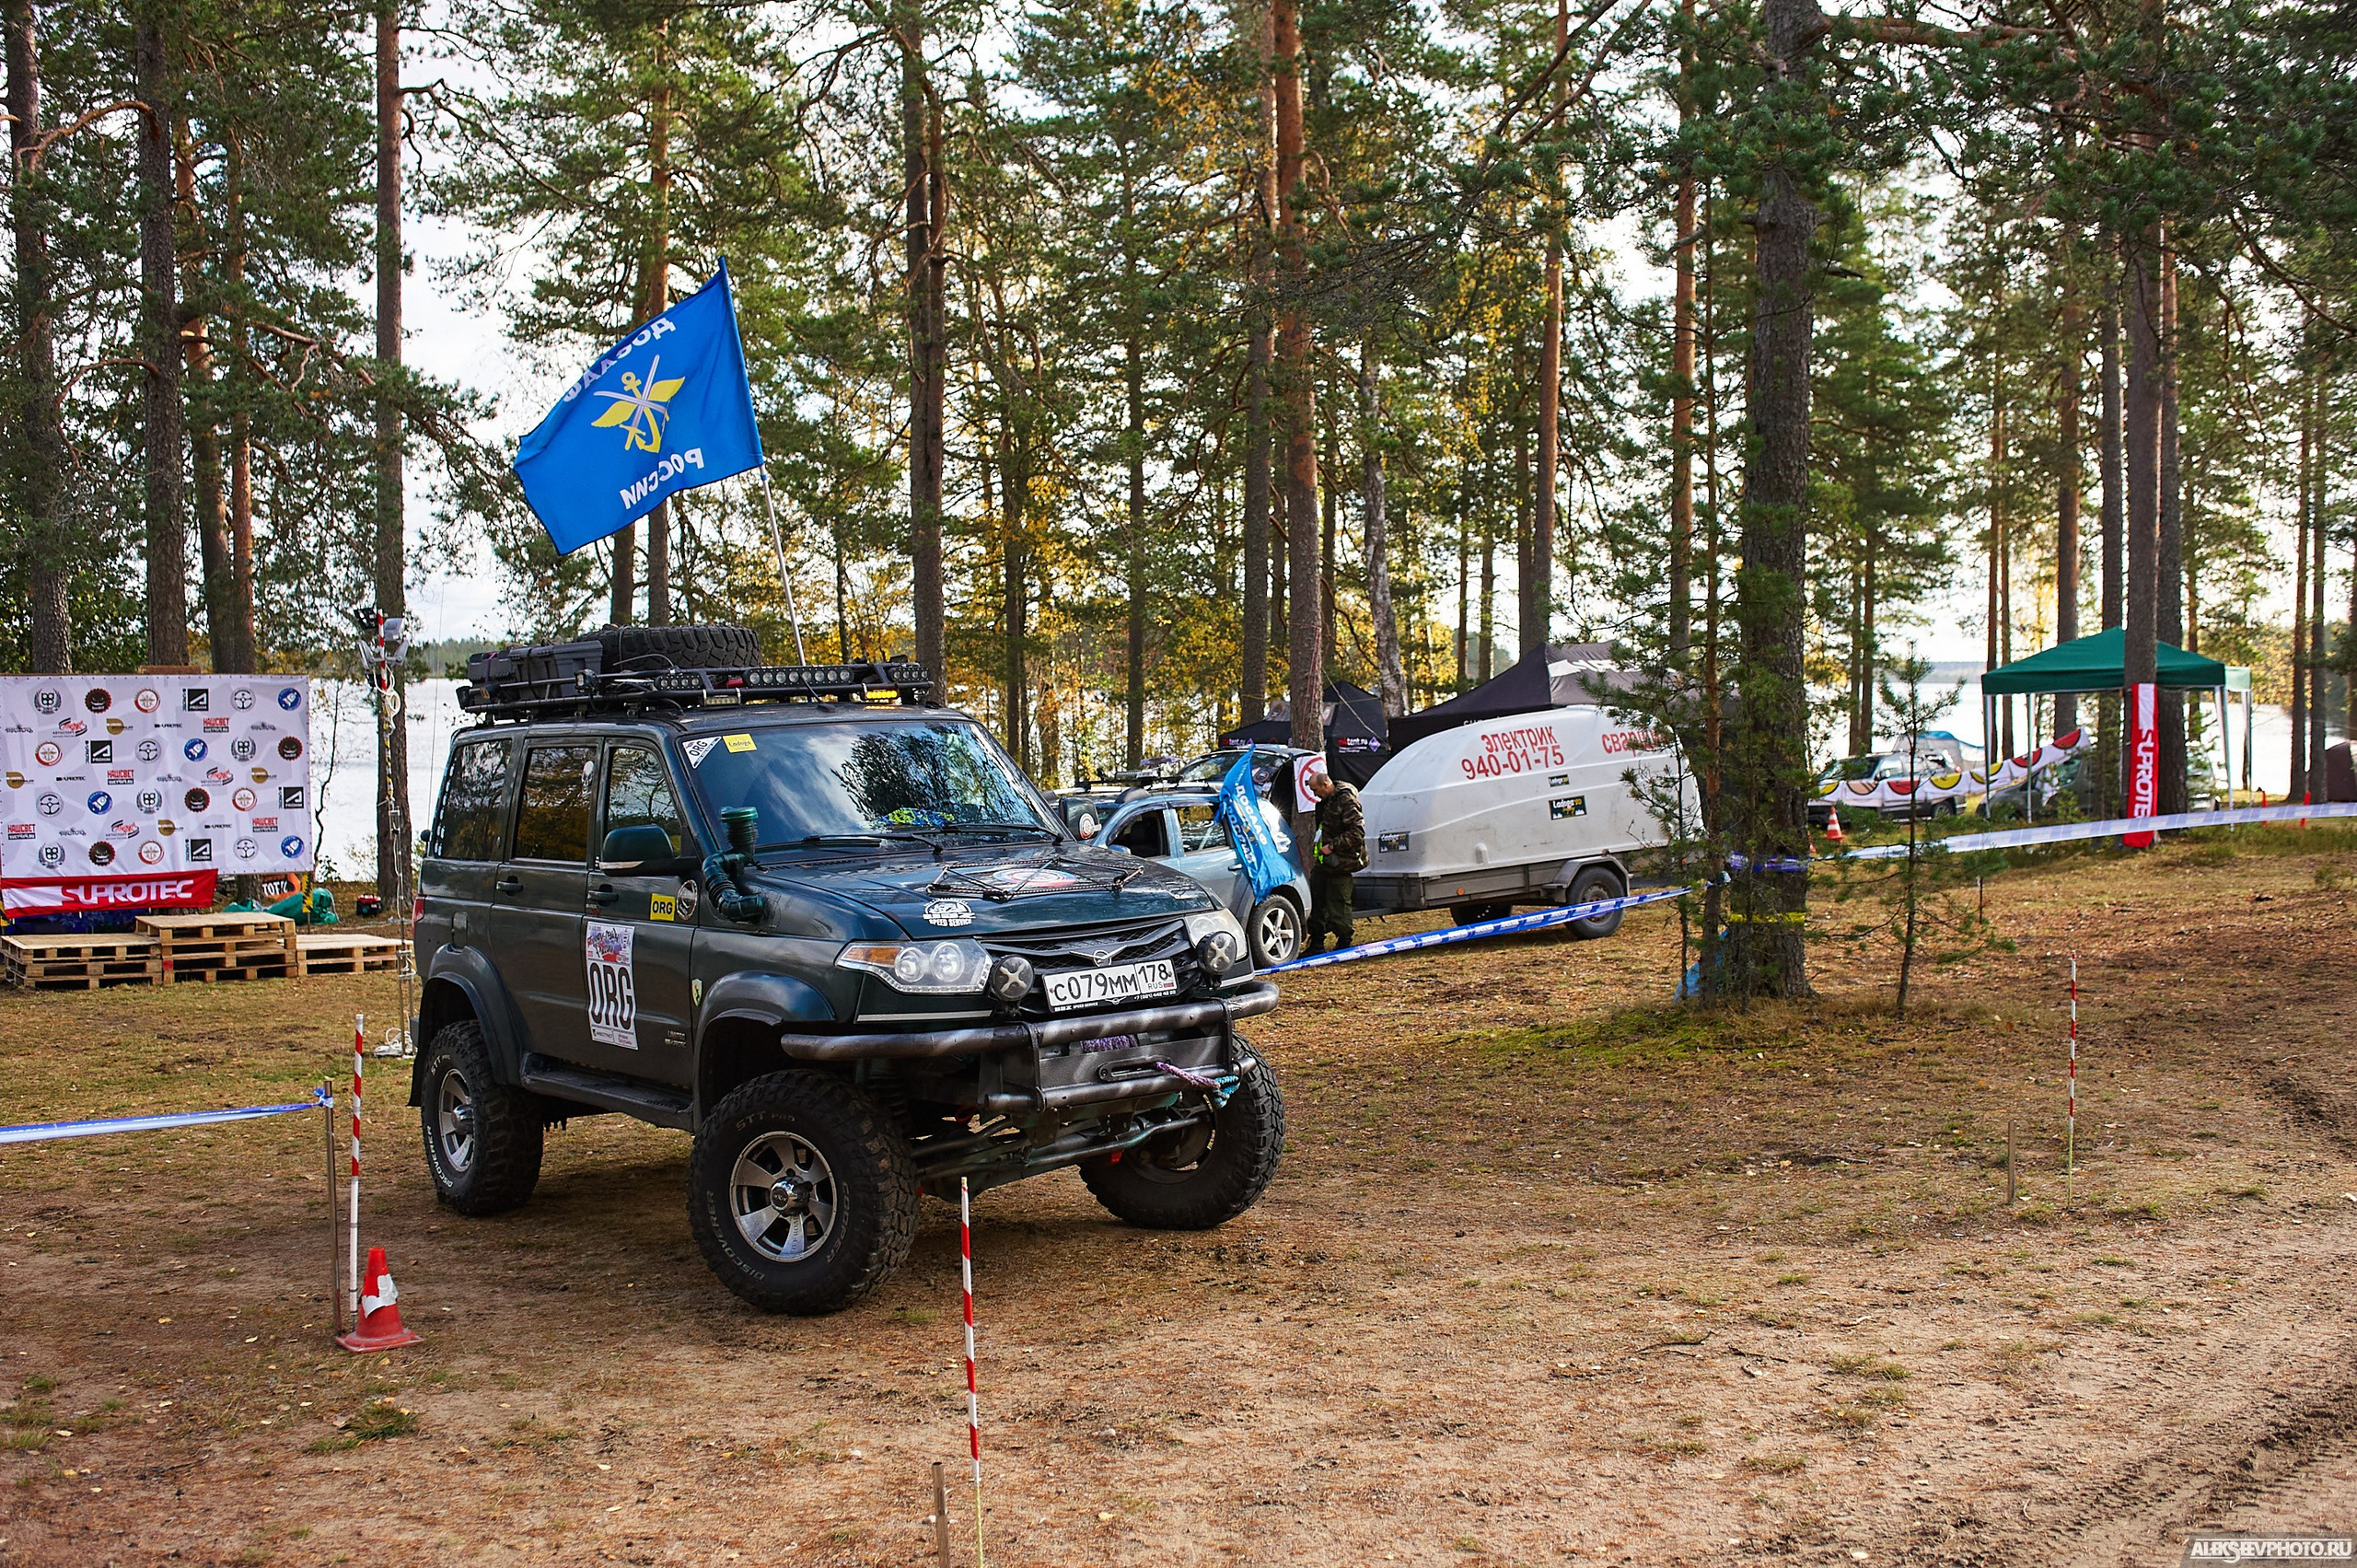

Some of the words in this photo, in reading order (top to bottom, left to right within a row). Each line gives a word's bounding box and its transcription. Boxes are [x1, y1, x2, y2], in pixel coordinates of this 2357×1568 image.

[689, 740, 708, 757] ORG
[1461, 745, 1565, 781] 940-01-75
[2133, 727, 2154, 819] SUPROTE
[61, 878, 194, 905] SUPROTEC
[652, 900, 673, 914] ORG
[1138, 963, 1168, 983] 178
[589, 962, 633, 1030] ORG
[1147, 981, 1164, 990] RUS
[430, 1055, 442, 1076] STT
[736, 1110, 767, 1132] STT
[826, 1181, 851, 1264] COOPER
[706, 1191, 766, 1282] DISCOVERER
